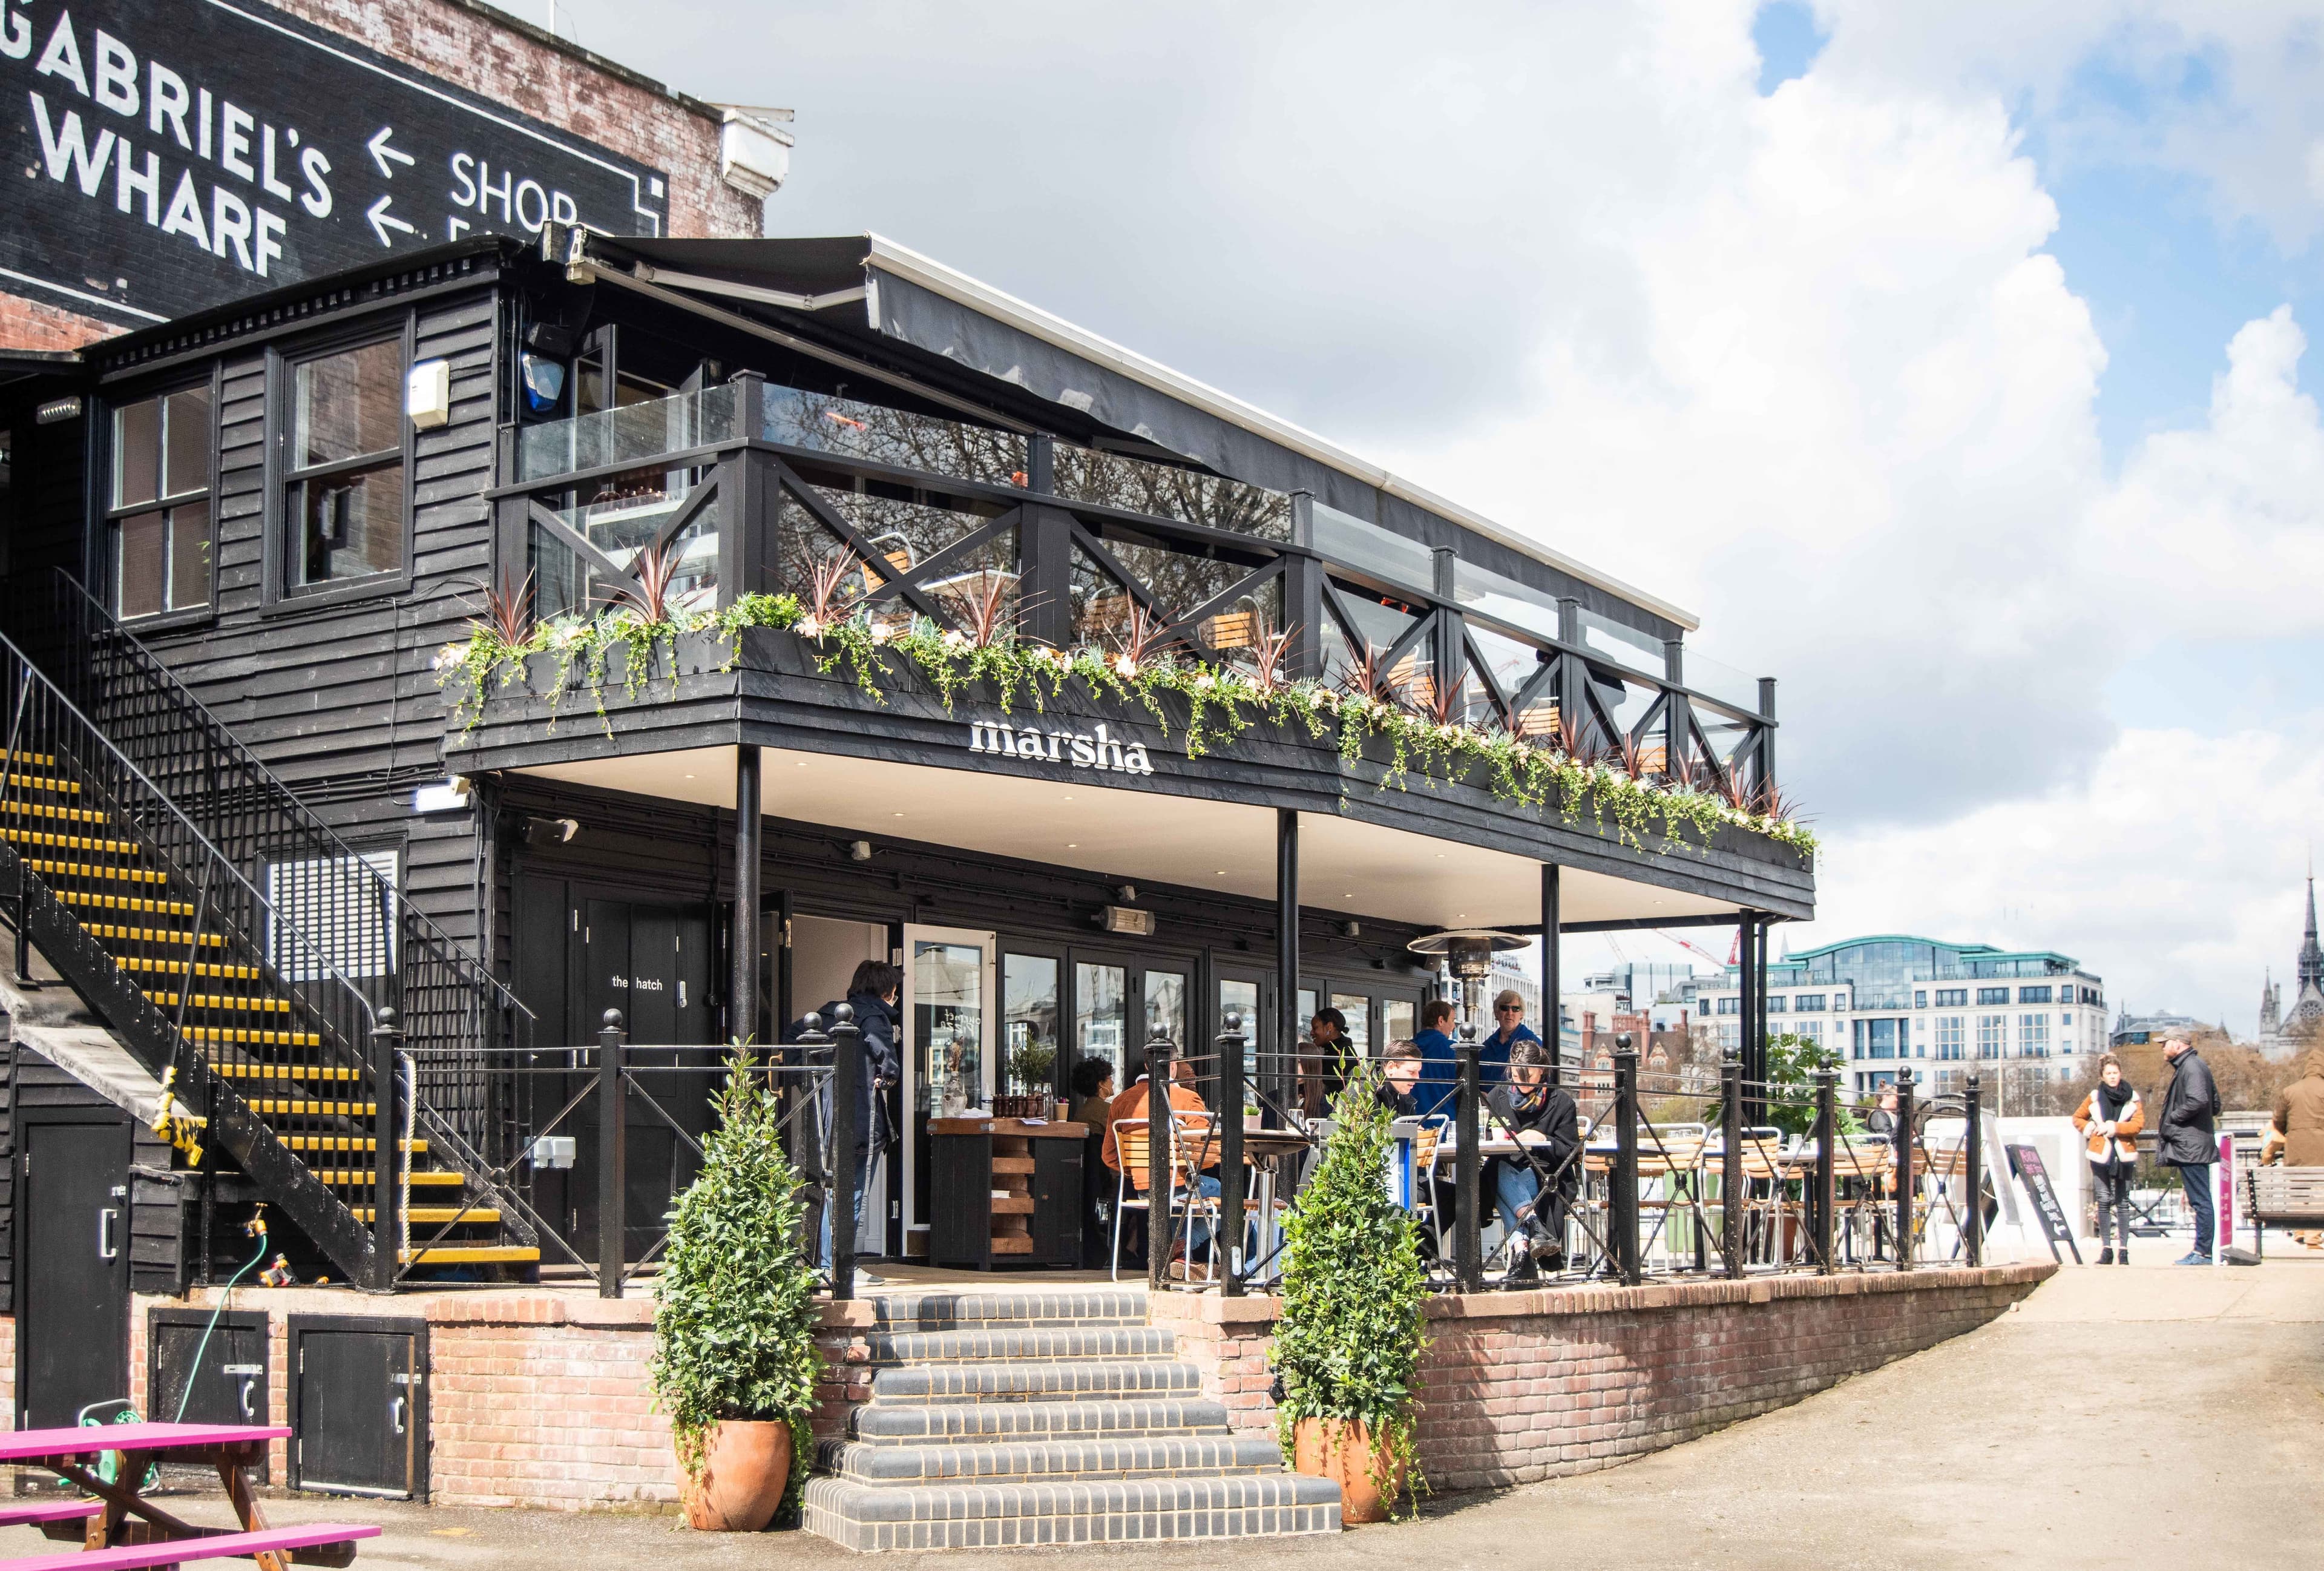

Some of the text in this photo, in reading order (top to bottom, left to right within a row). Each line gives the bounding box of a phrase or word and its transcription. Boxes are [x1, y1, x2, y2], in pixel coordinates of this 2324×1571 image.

[0, 0, 332, 218] GABRIEL'S
[30, 90, 286, 278] WHARF
[451, 153, 577, 233] SHOP
[968, 720, 1154, 776] marsha
[612, 975, 663, 990] the hatch
